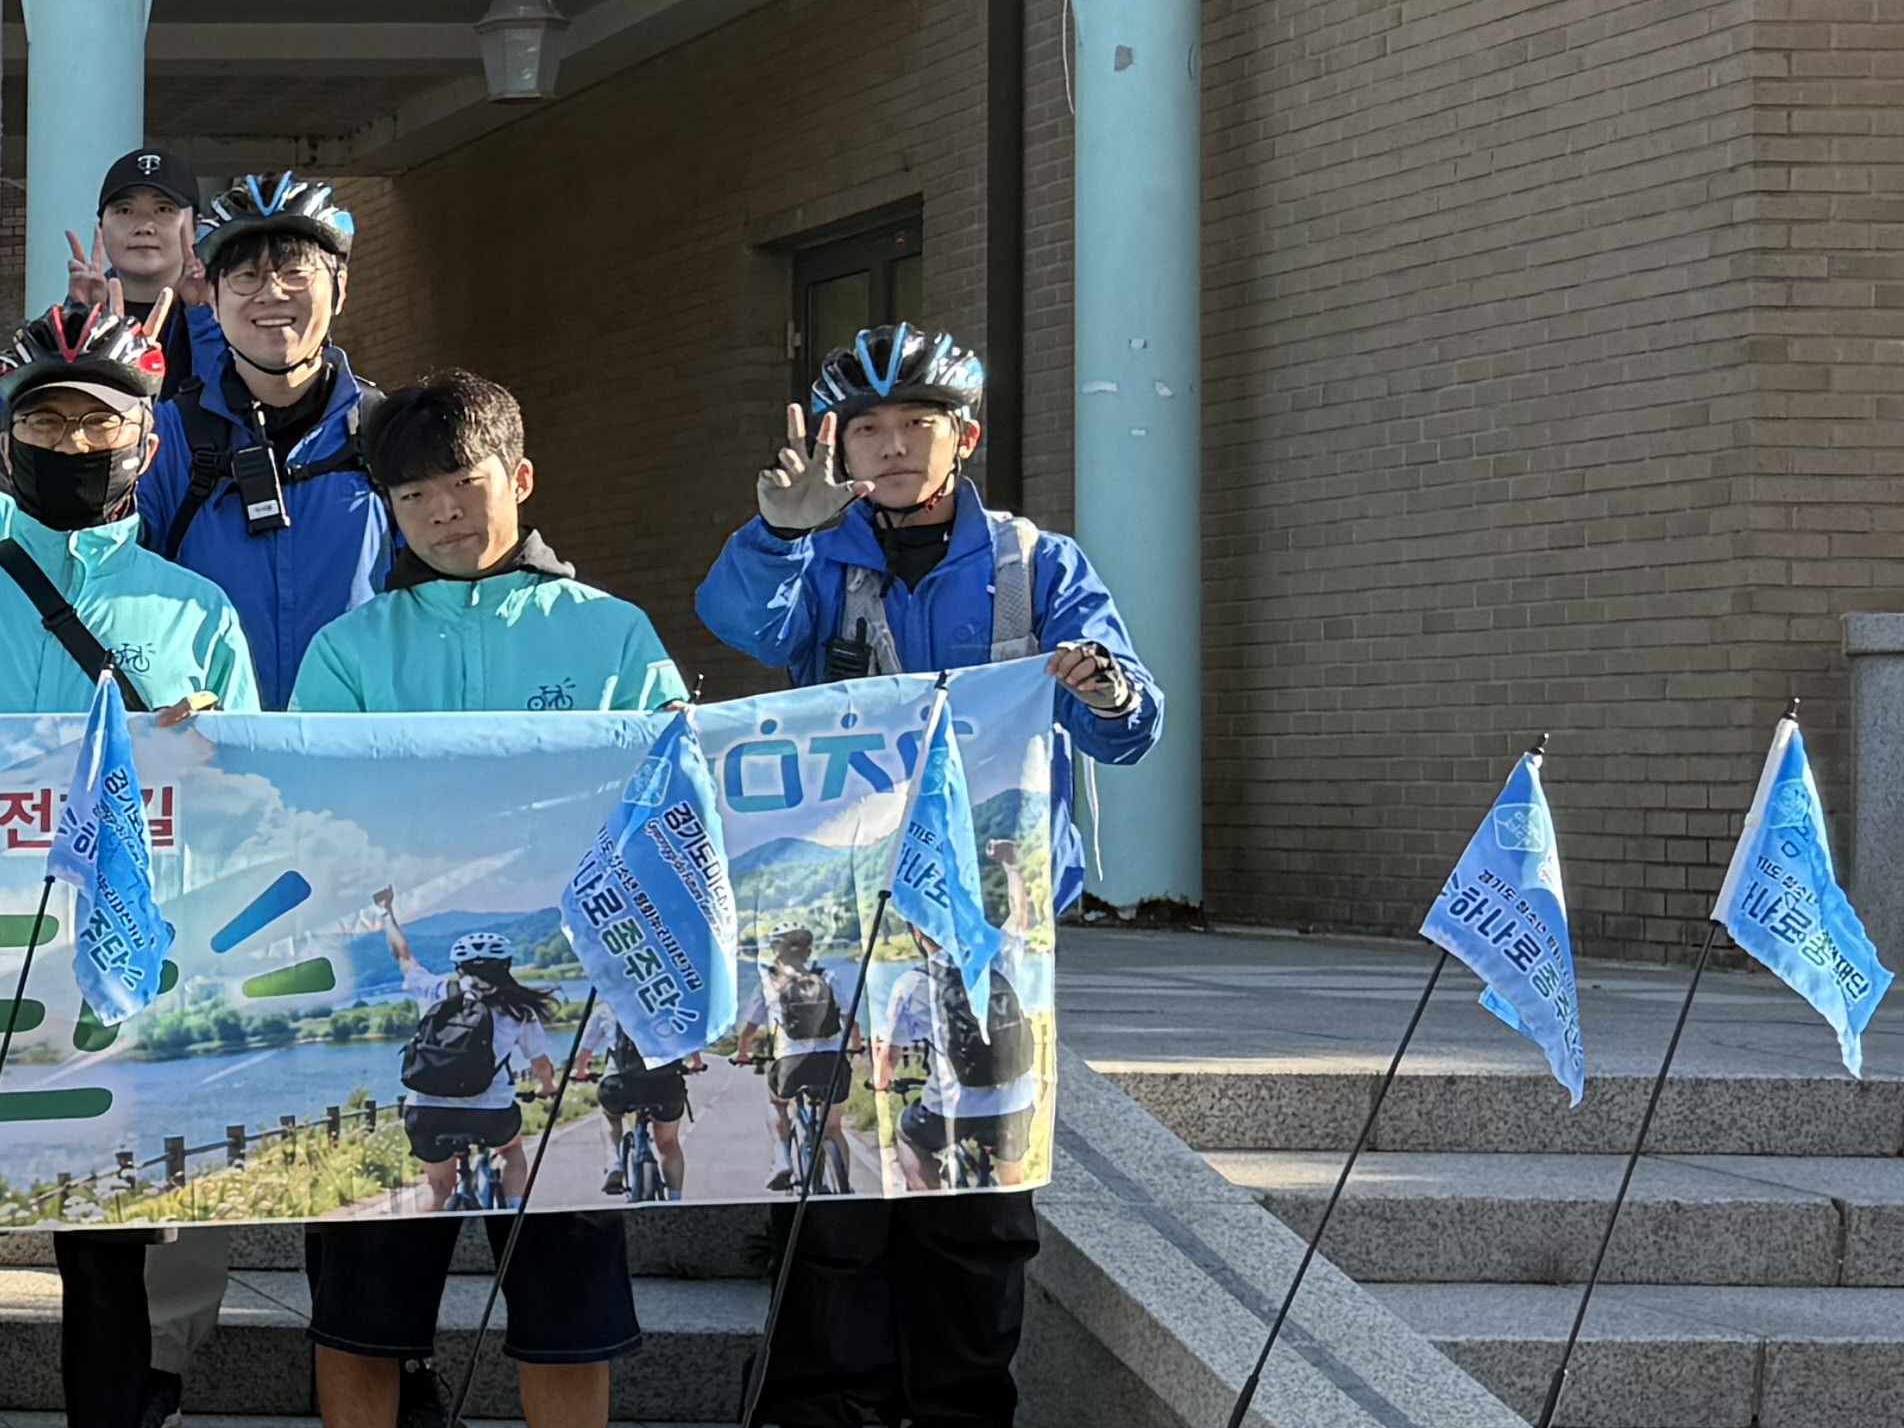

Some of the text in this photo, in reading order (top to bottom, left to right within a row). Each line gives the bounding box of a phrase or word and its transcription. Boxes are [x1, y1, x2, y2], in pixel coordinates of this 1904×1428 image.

[1449, 885, 1543, 973] 하나로
[1741, 880, 1815, 945] 나로
[601, 918, 685, 1015] 종주단
